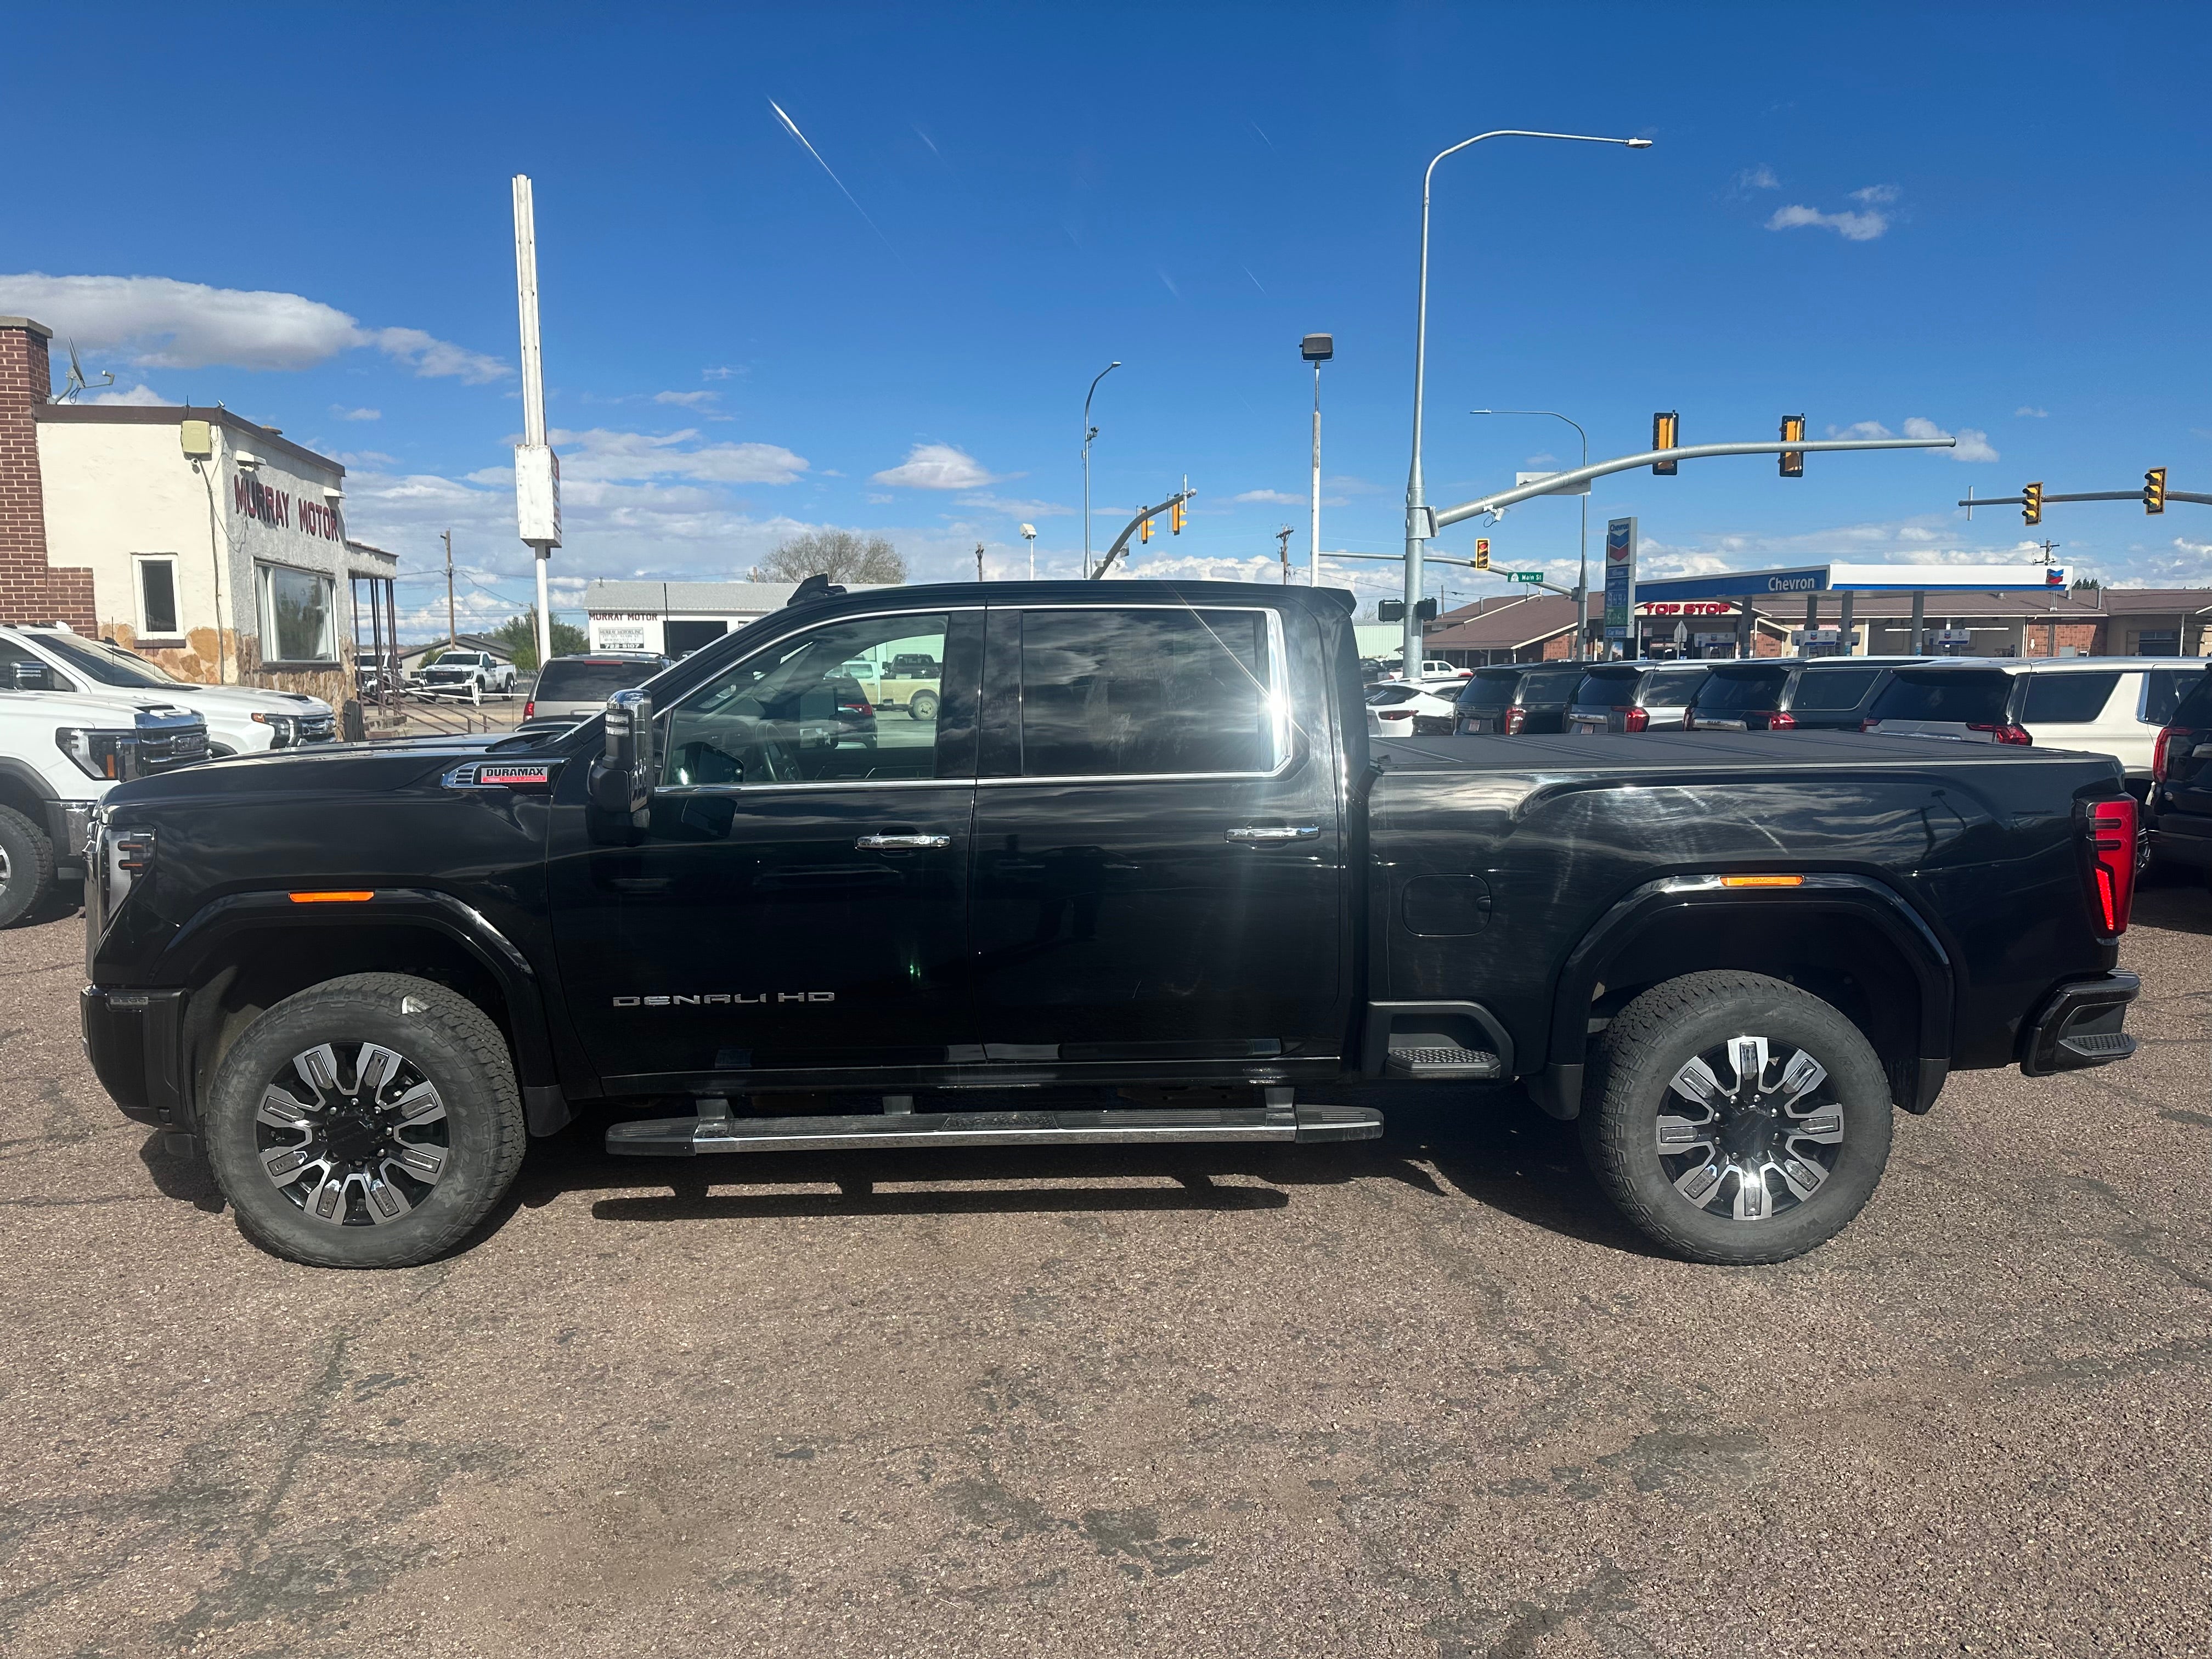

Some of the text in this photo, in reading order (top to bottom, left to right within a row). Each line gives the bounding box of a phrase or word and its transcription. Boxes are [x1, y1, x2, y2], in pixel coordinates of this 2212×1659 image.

[234, 475, 338, 543] MURRAY MOTOR
[1610, 523, 1629, 532] Chevron
[1768, 577, 1815, 591] Chevron
[1644, 603, 1731, 615] TOP STOP
[628, 613, 658, 621] MOTOR
[486, 768, 544, 776] DURAMAX
[613, 992, 834, 1007] DENALI HD
